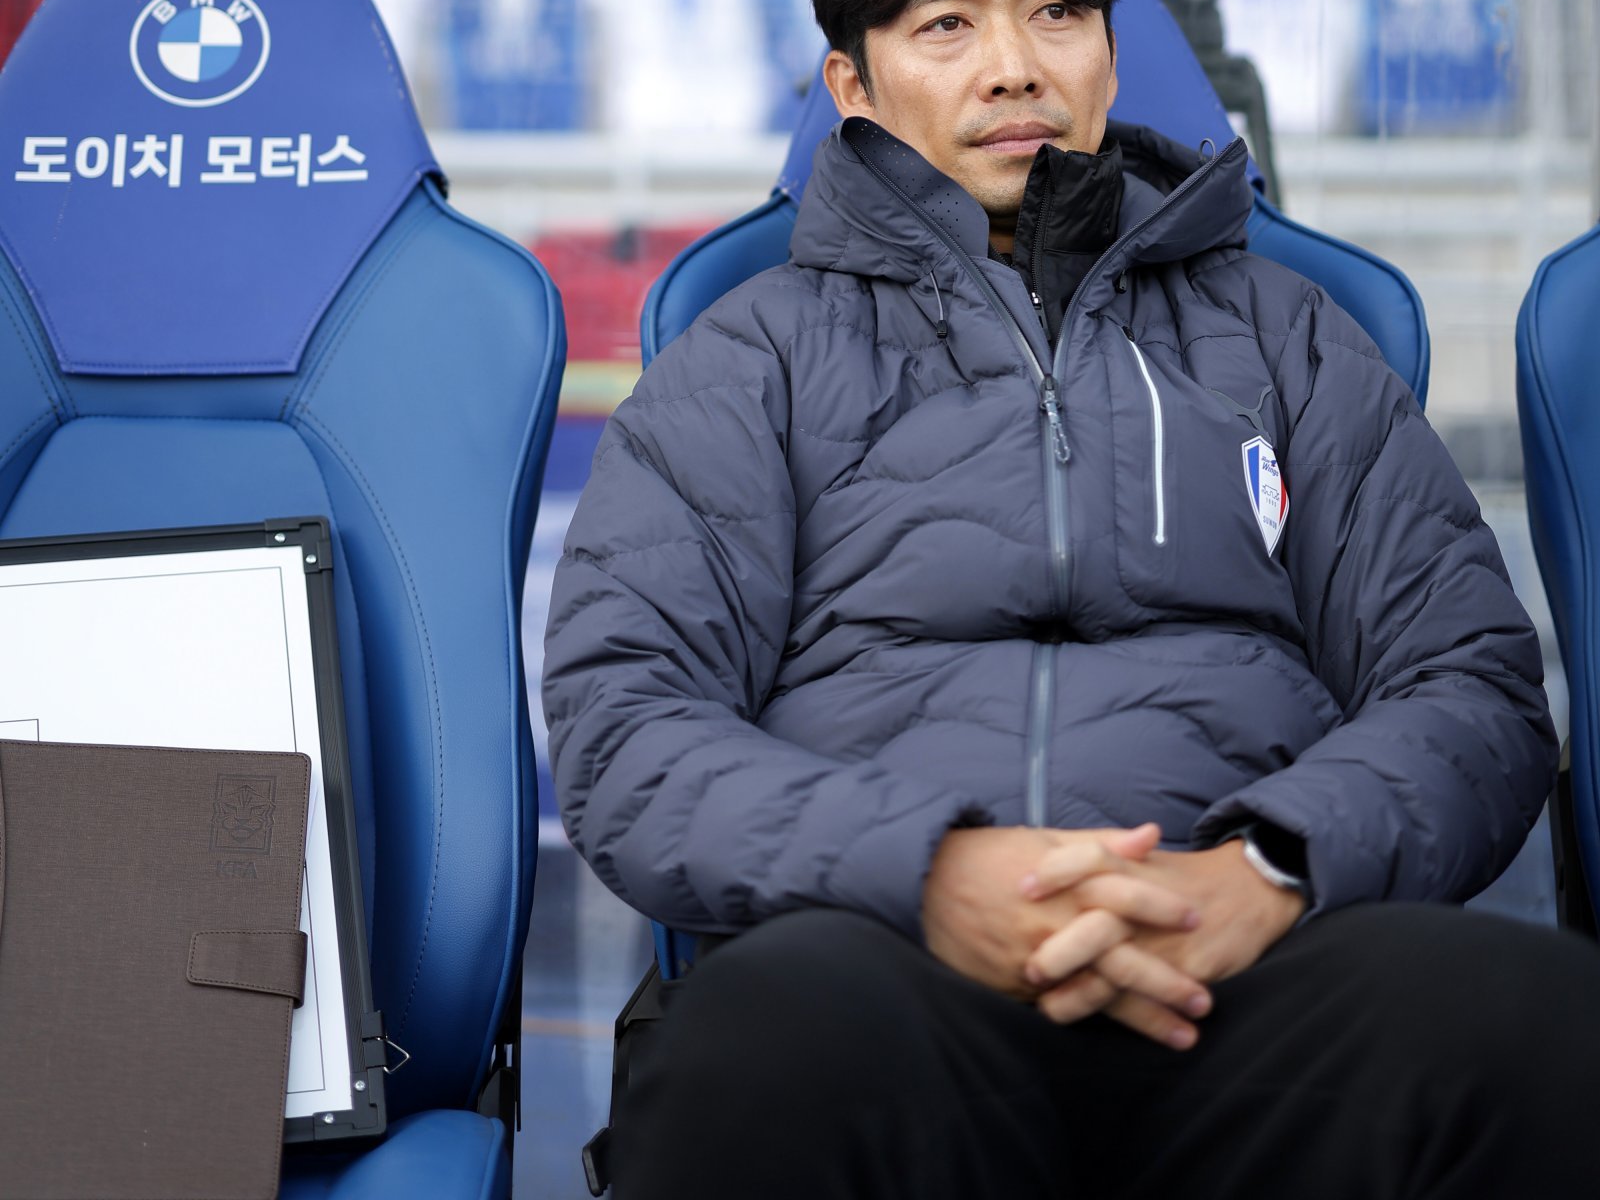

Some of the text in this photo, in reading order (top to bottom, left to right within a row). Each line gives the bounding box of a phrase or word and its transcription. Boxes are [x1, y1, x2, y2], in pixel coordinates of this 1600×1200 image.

[14, 133, 369, 188] 도이치 모터스
[1262, 461, 1279, 477] Wings
